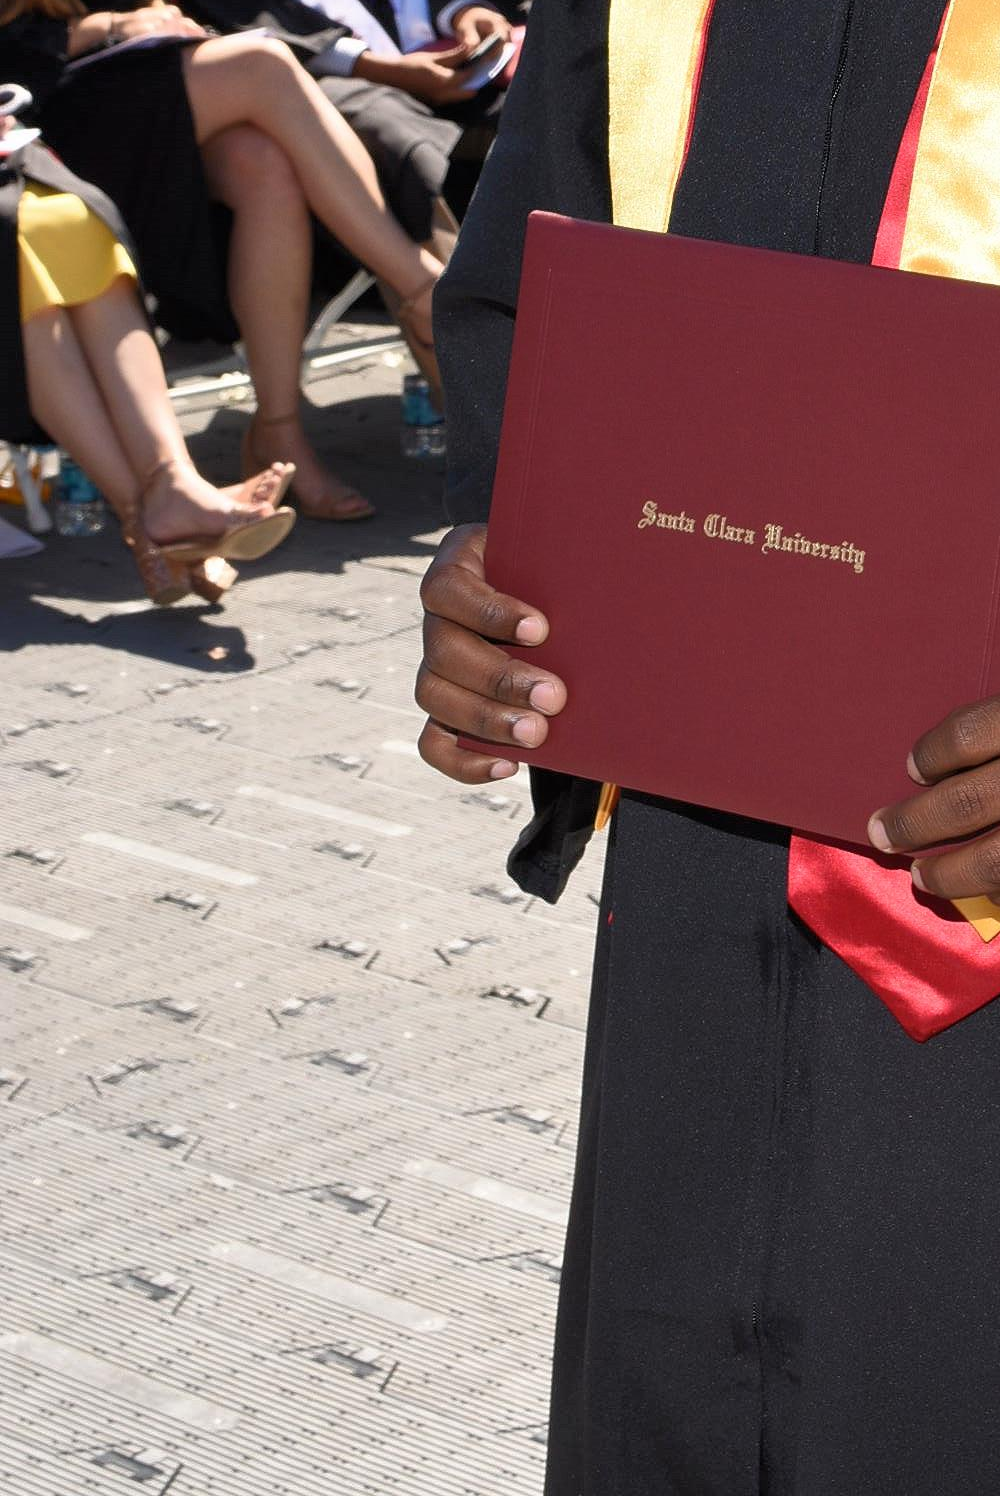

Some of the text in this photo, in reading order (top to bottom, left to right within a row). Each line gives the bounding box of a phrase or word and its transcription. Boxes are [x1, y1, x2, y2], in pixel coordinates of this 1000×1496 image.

[637, 501, 866, 574] Santa Clara University
